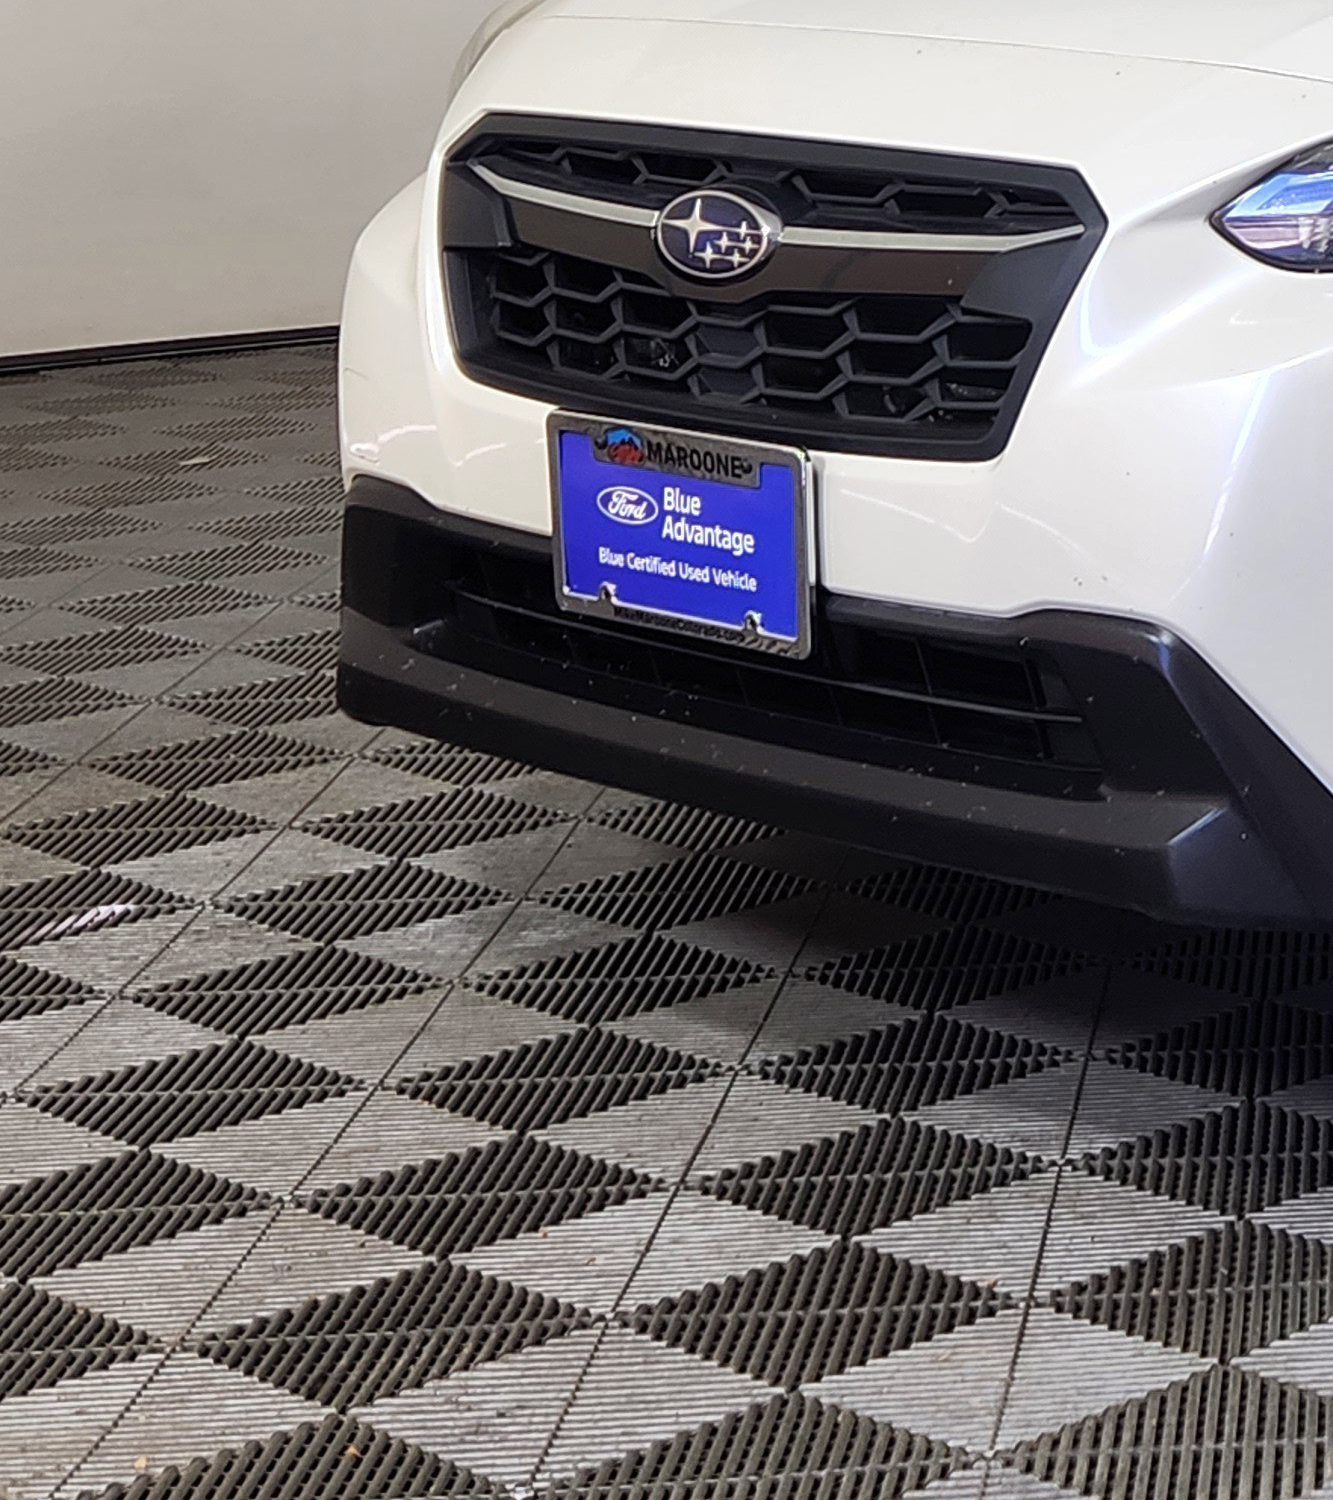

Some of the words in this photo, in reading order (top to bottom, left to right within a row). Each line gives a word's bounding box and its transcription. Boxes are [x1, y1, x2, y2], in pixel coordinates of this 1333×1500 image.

[647, 441, 743, 478] MAROONE
[608, 490, 647, 519] Ford
[663, 487, 701, 516] Blue
[661, 515, 755, 556] Advantage
[598, 546, 625, 567] Blue
[627, 552, 676, 577] Certified
[678, 562, 710, 583] Used
[712, 567, 757, 592] Vehicle
